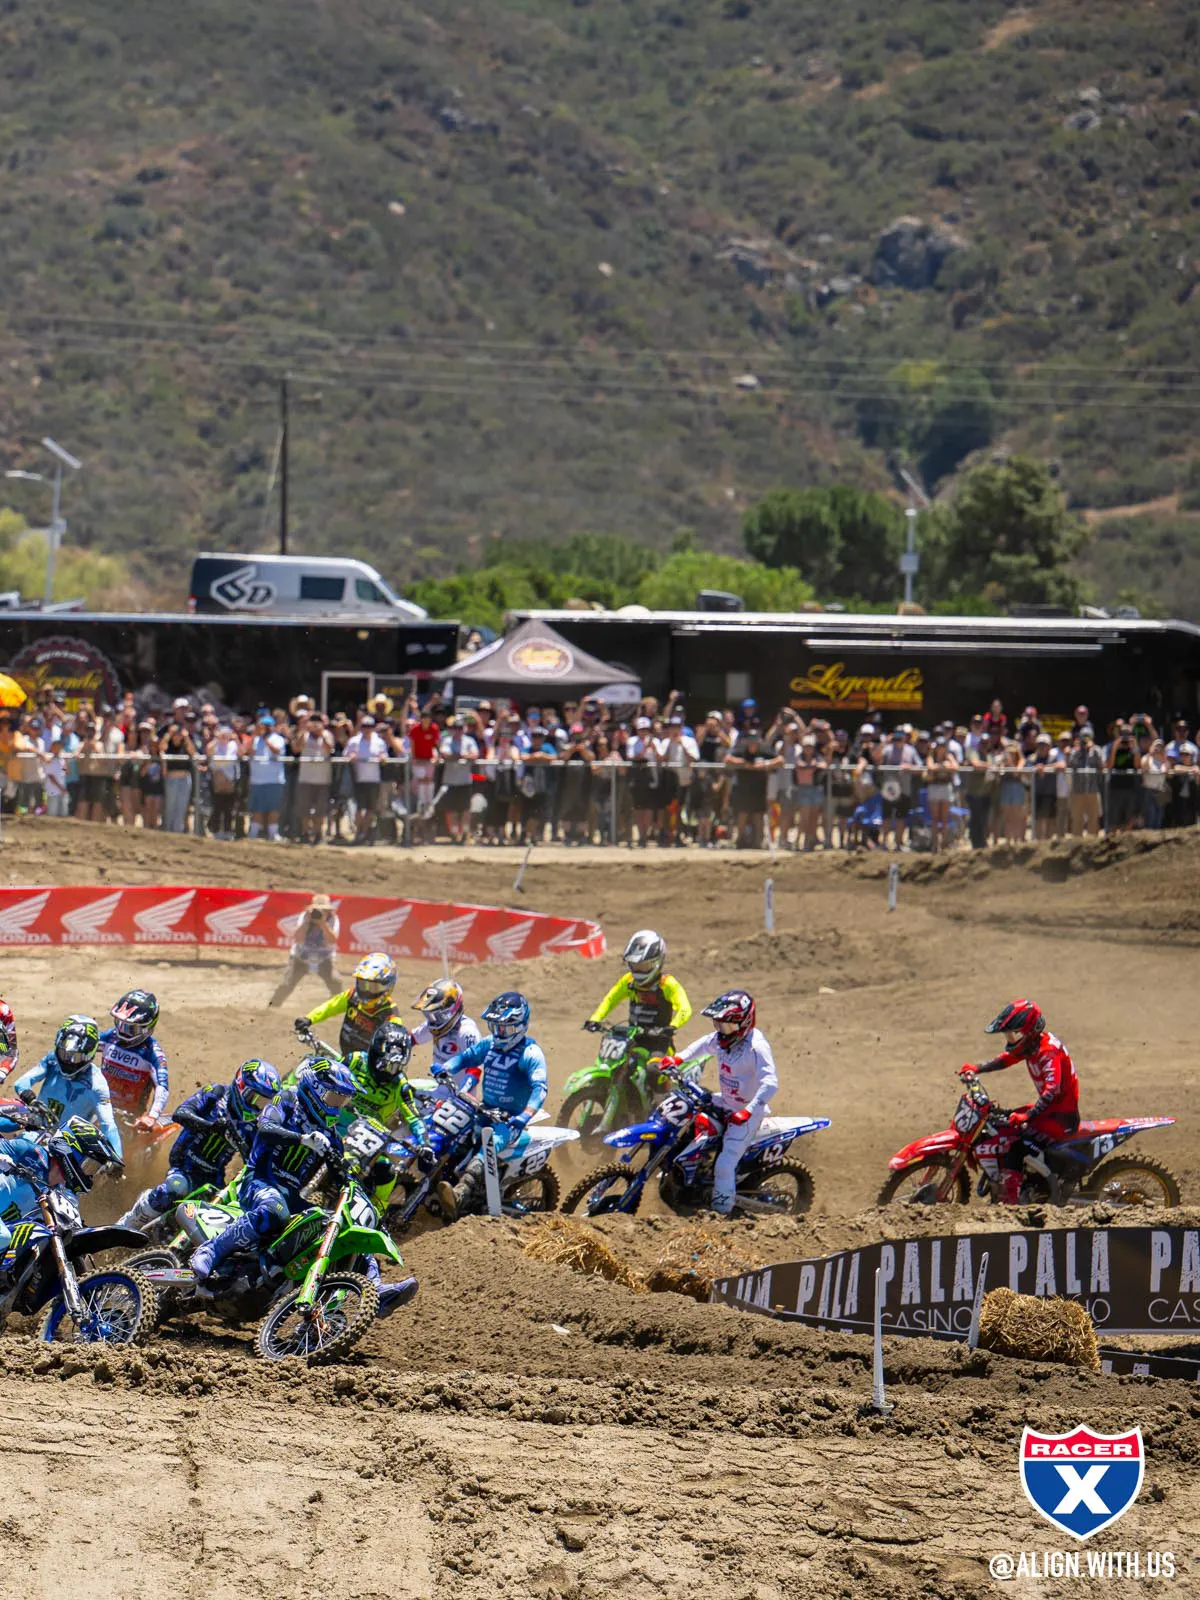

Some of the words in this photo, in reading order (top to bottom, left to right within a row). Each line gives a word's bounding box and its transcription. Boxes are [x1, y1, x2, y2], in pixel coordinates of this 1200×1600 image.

[61, 931, 125, 943] HONDA
[133, 930, 198, 943] HONDA
[204, 932, 269, 945] HONDA
[349, 941, 413, 956] HONDA
[483, 1051, 519, 1071] FLY
[432, 1101, 471, 1136] 22
[661, 1092, 689, 1127] 42
[526, 1150, 547, 1176] 22
[762, 1143, 784, 1165] 42
[880, 1237, 975, 1308] PALA
[1008, 1230, 1111, 1296] PALA
[795, 1251, 861, 1319] PALA
